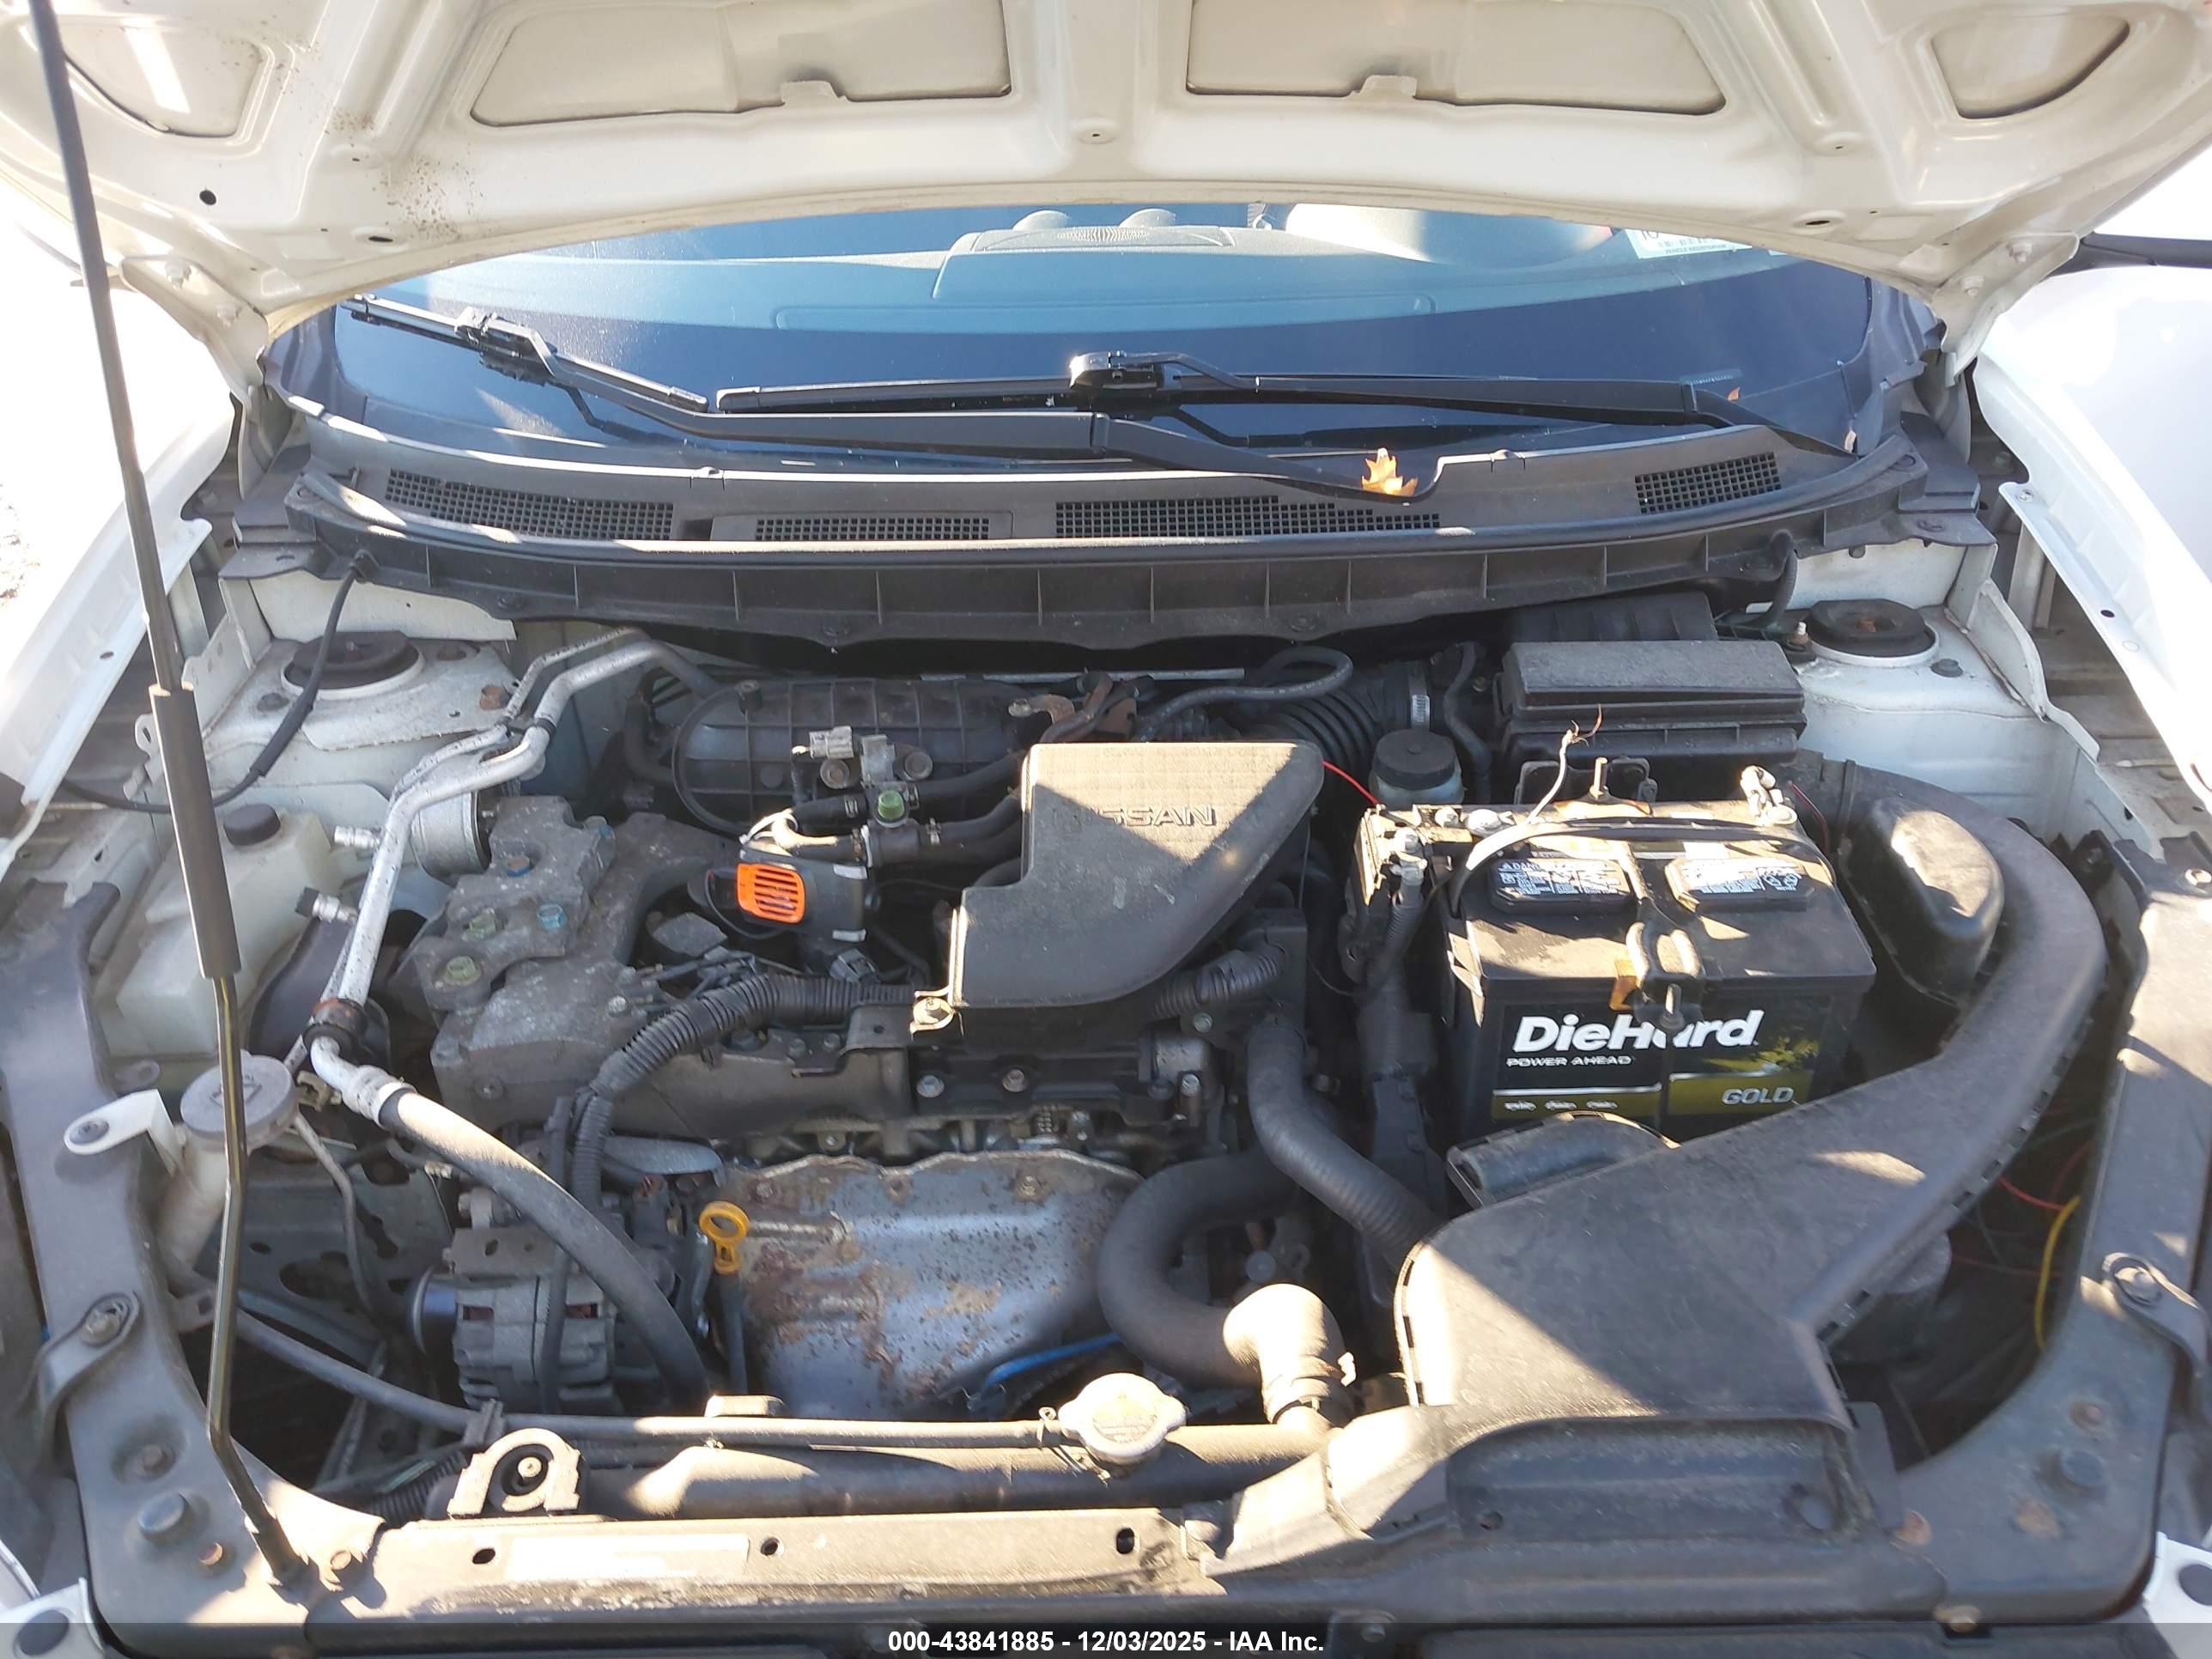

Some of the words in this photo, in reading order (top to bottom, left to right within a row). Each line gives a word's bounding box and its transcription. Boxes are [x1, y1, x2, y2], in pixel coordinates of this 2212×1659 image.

[1073, 805, 1217, 827] SSAN
[1506, 1057, 1568, 1066] POWER
[1571, 1055, 1632, 1065] AHEAD
[1722, 1086, 1795, 1105] GOLD
